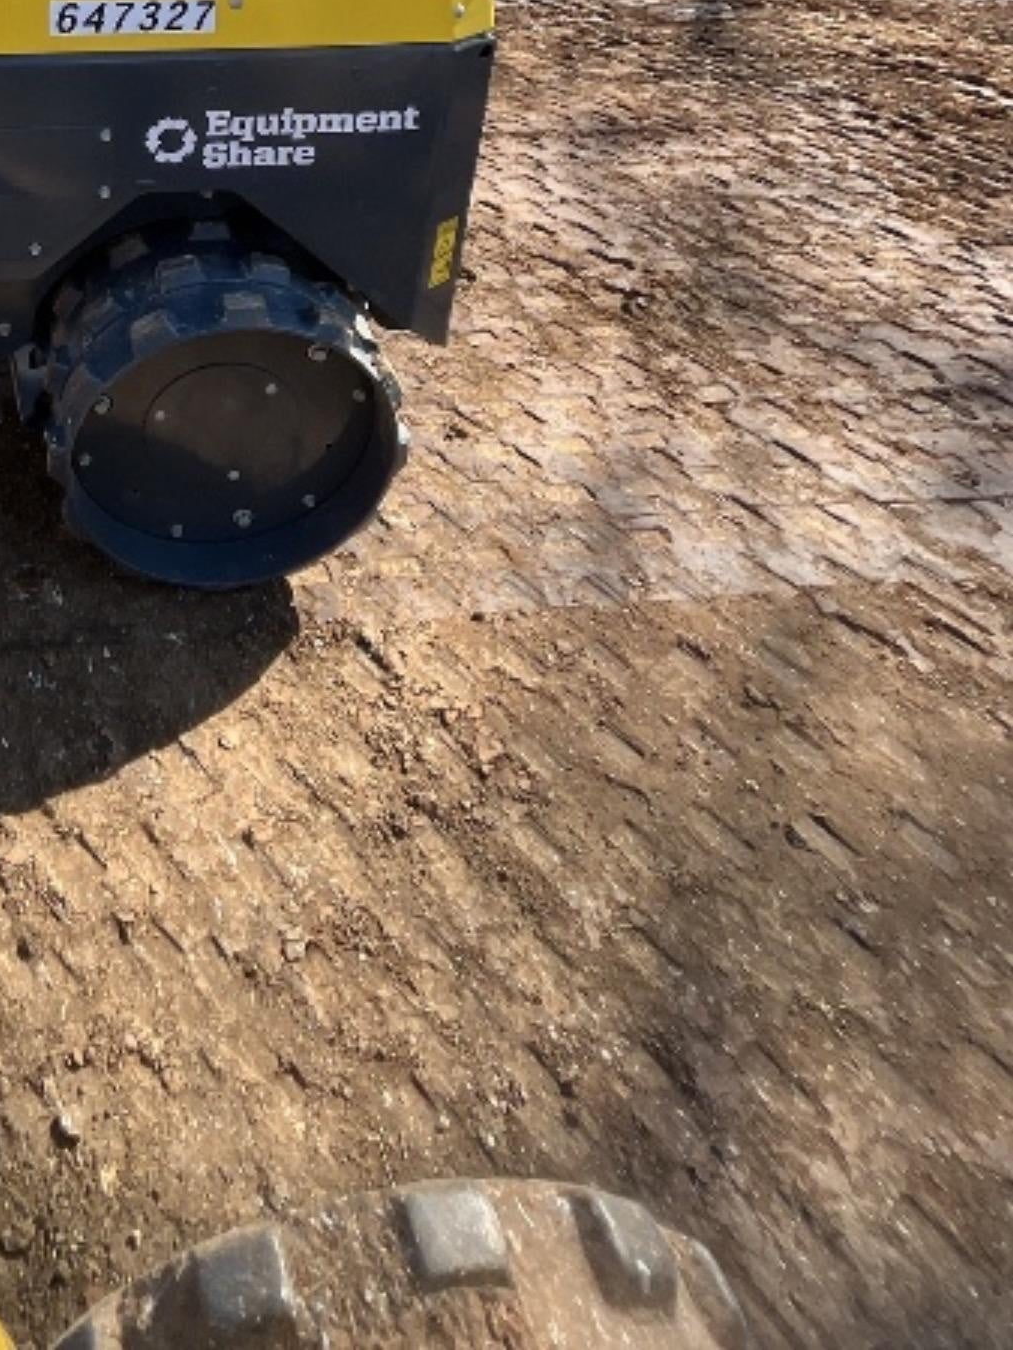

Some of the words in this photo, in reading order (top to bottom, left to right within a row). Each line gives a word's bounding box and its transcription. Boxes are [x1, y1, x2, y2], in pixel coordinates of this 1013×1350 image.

[55, 0, 217, 34] 647327
[204, 106, 421, 142] Equipment
[202, 142, 316, 169] Share
